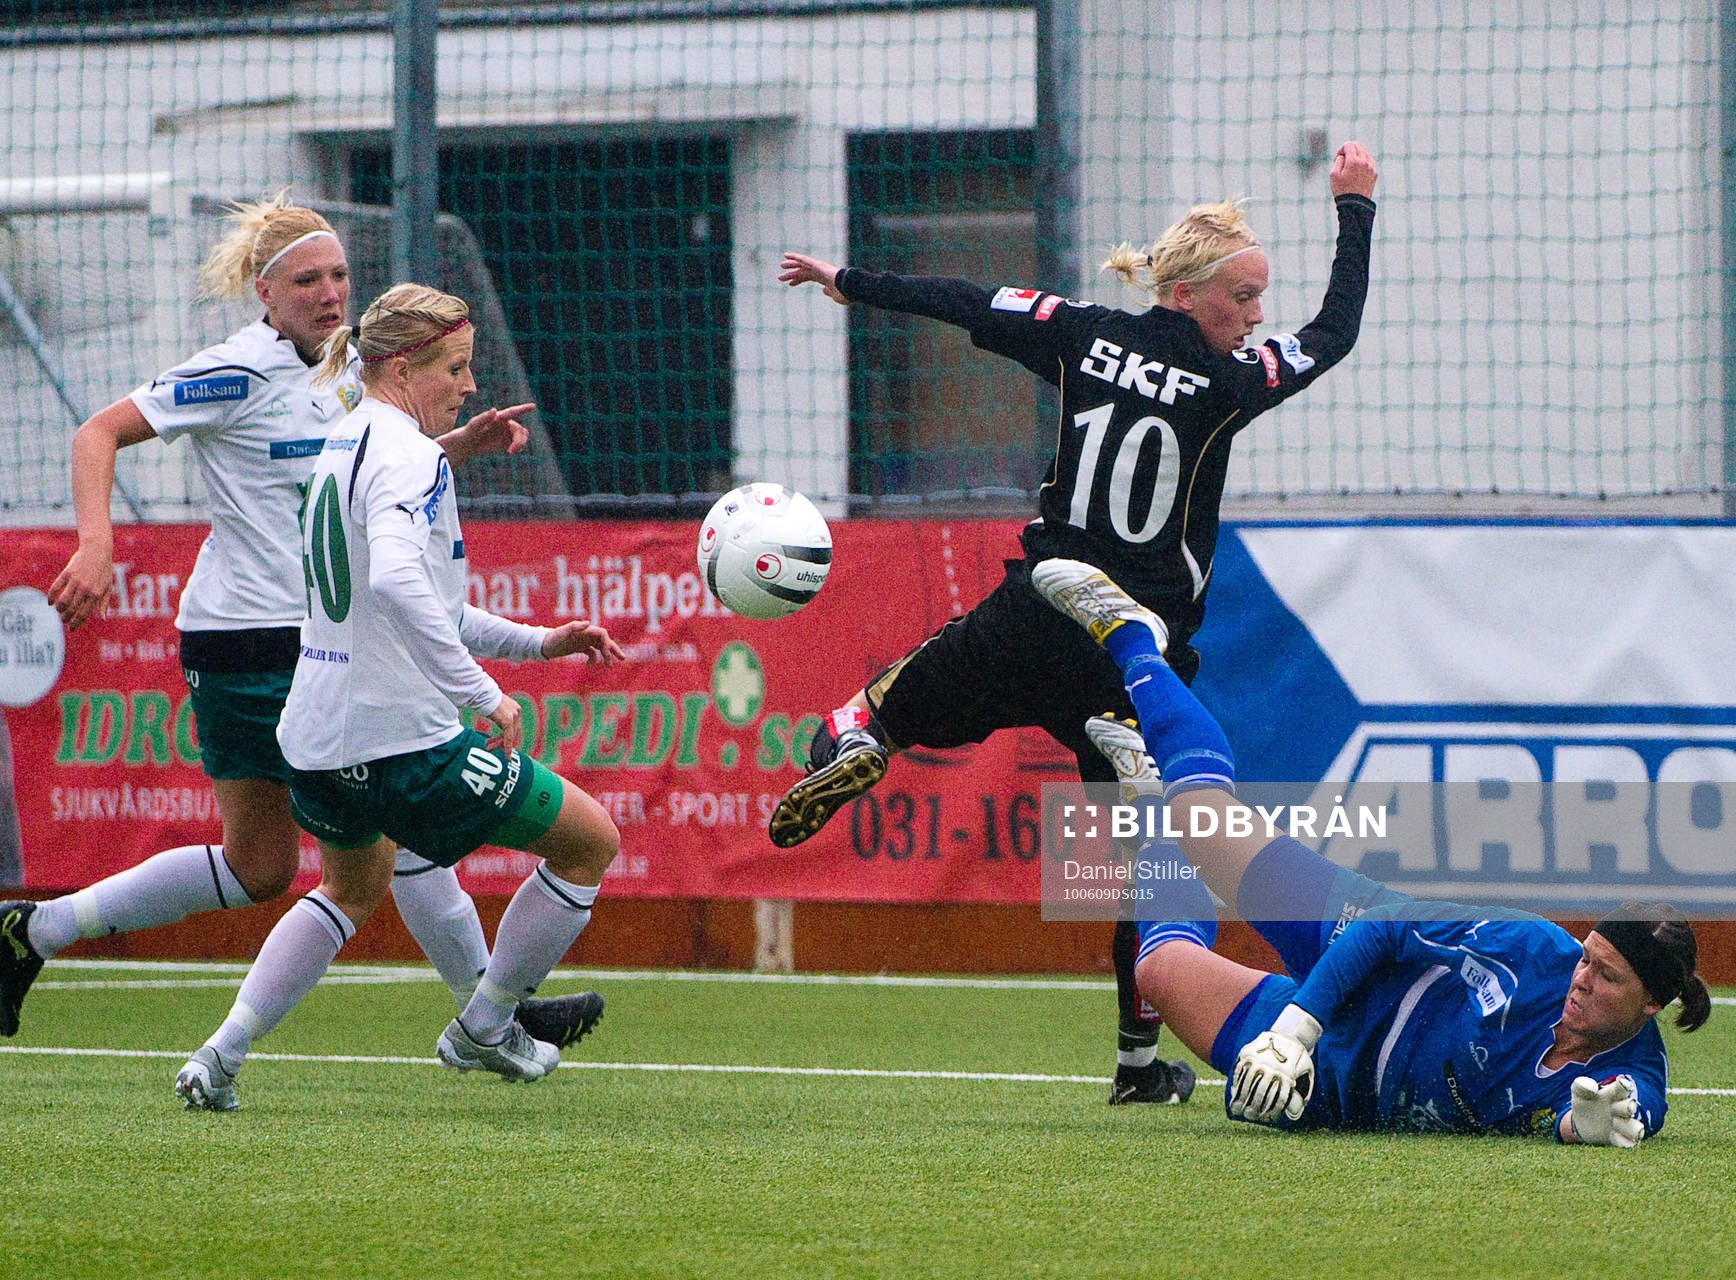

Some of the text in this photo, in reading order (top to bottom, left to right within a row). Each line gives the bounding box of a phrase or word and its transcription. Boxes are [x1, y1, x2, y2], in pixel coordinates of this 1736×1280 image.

[183, 383, 241, 399] Folksam
[1080, 338, 1210, 405] SKF
[1068, 402, 1181, 543] 10
[327, 650, 350, 664] BUSS
[461, 747, 503, 797] 40
[668, 792, 749, 827] SPORT
[1324, 744, 1736, 875] ARRO
